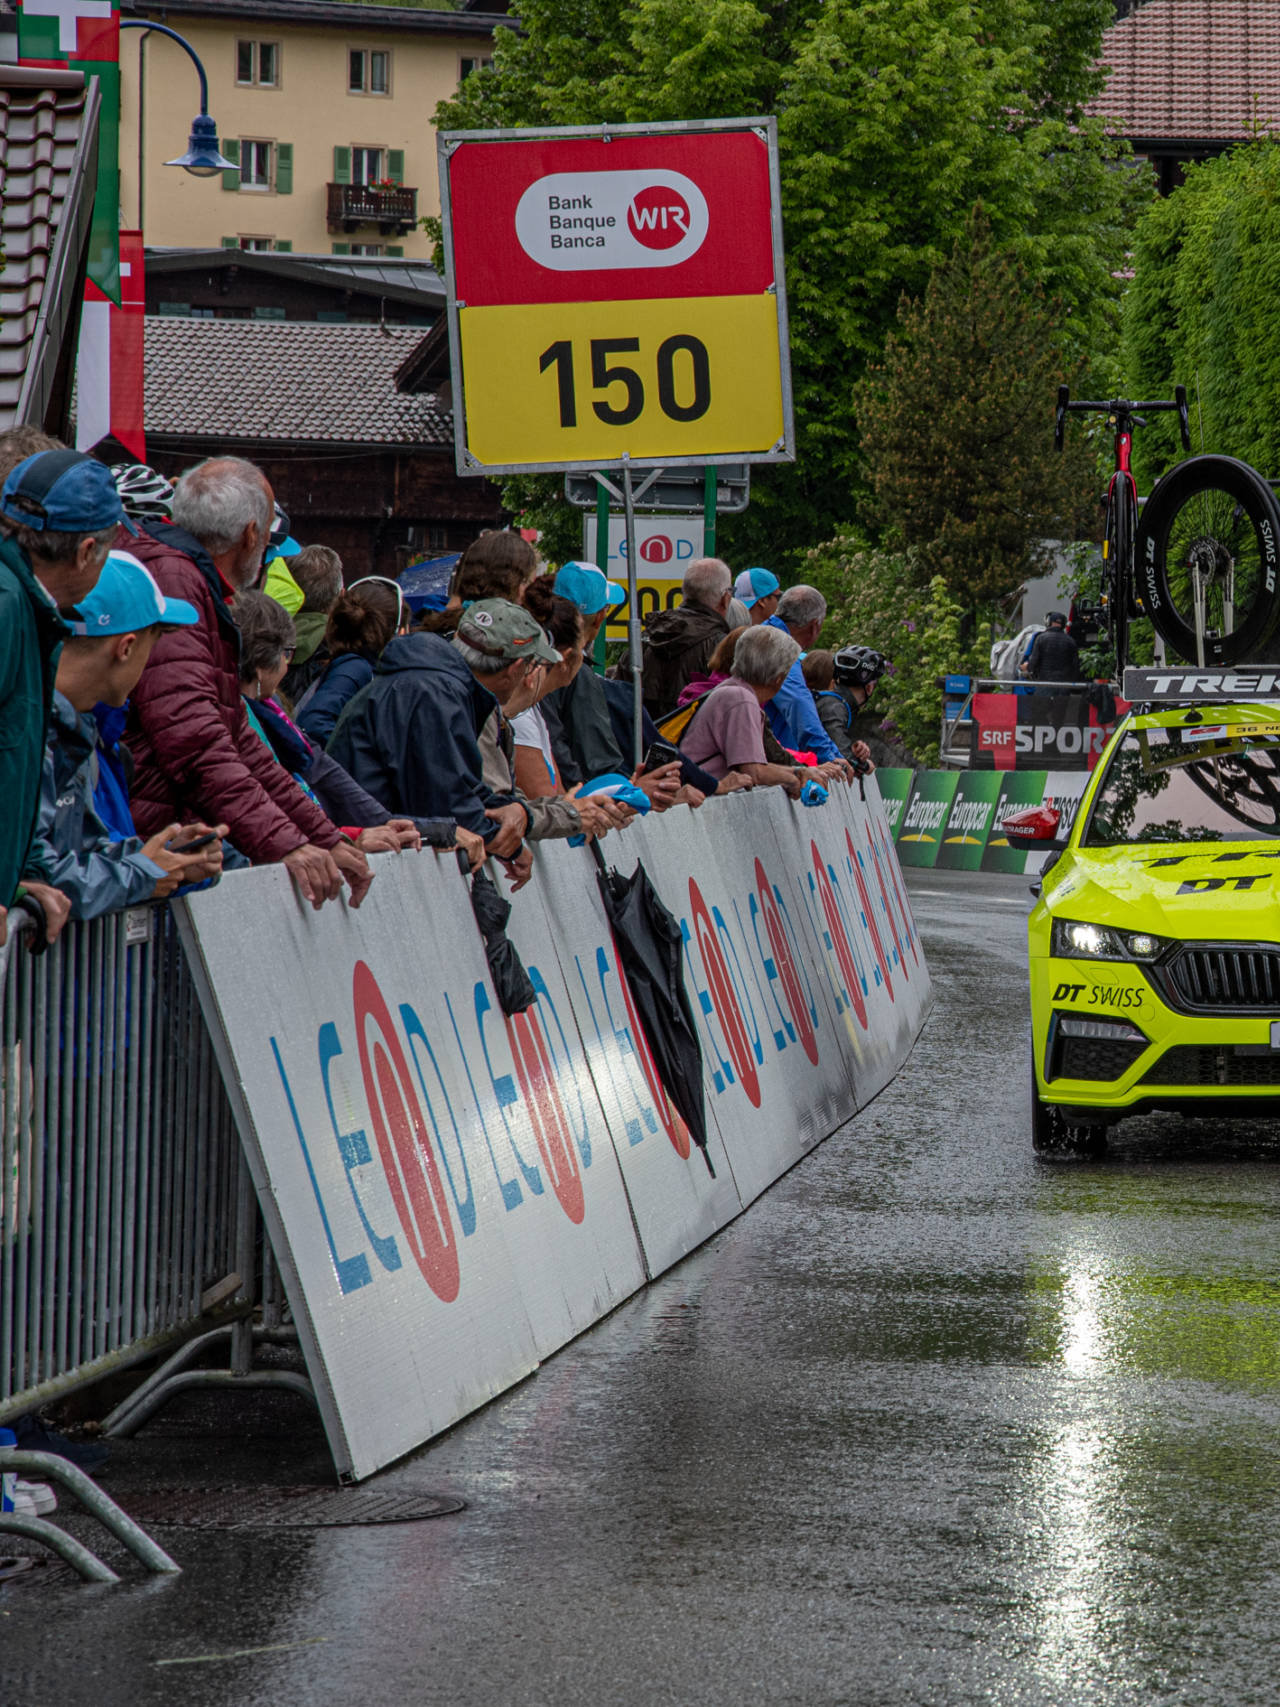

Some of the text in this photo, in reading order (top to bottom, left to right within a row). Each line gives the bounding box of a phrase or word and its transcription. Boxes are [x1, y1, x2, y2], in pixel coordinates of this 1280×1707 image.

[549, 195, 593, 210] Bank
[550, 215, 616, 231] Banque
[630, 203, 690, 235] WIR
[551, 235, 606, 249] Banca
[539, 334, 711, 428] 150
[982, 725, 1116, 754] SRF SPOR
[1175, 873, 1273, 895] DT
[1052, 984, 1145, 1008] DT SWISS
